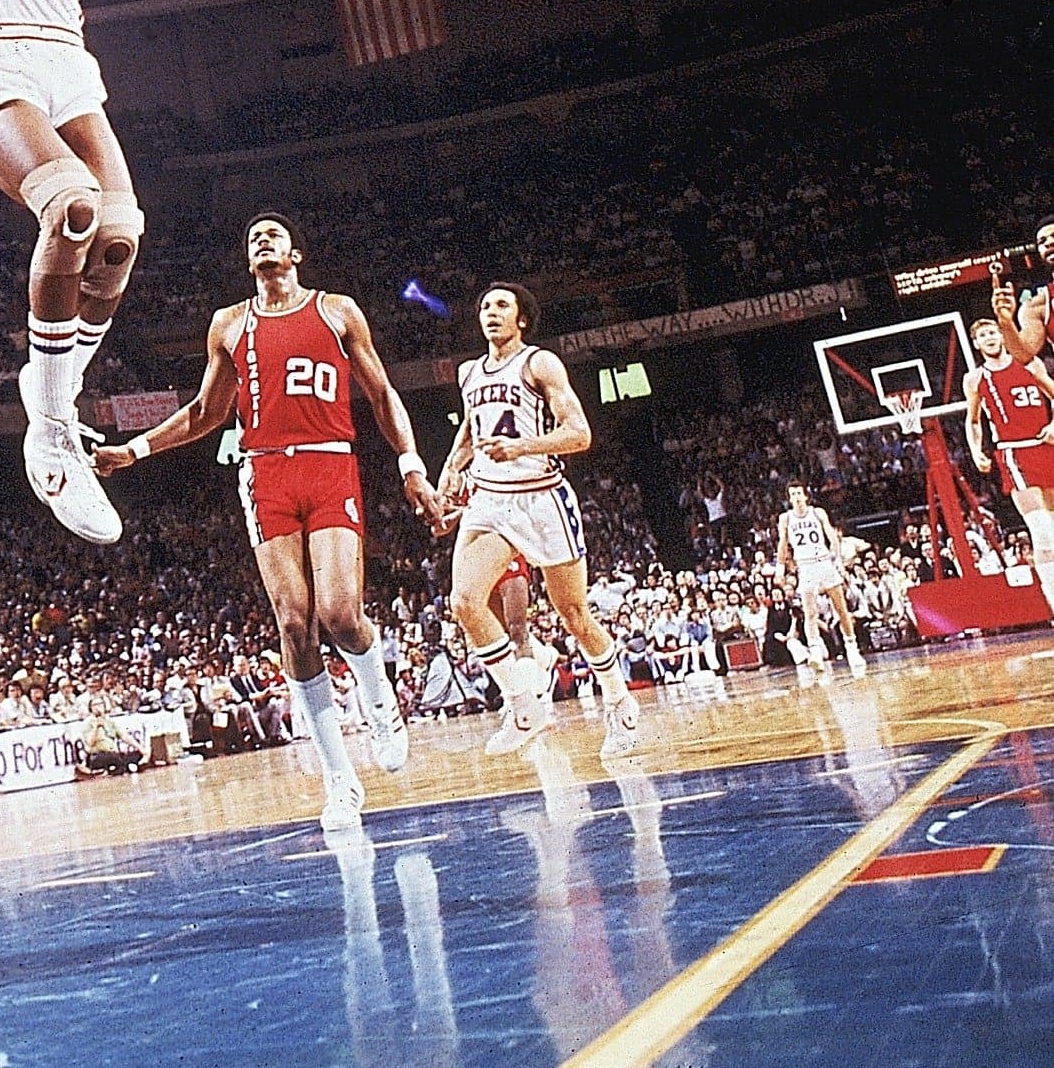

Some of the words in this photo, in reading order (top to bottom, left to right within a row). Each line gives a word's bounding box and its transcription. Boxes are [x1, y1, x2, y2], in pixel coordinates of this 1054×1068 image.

[639, 313, 693, 338] WAY
[285, 357, 338, 403] 20
[1009, 384, 1043, 408] 32
[474, 408, 522, 439] 14
[794, 530, 821, 547] 20
[12, 740, 45, 776] For
[48, 730, 87, 767] The
